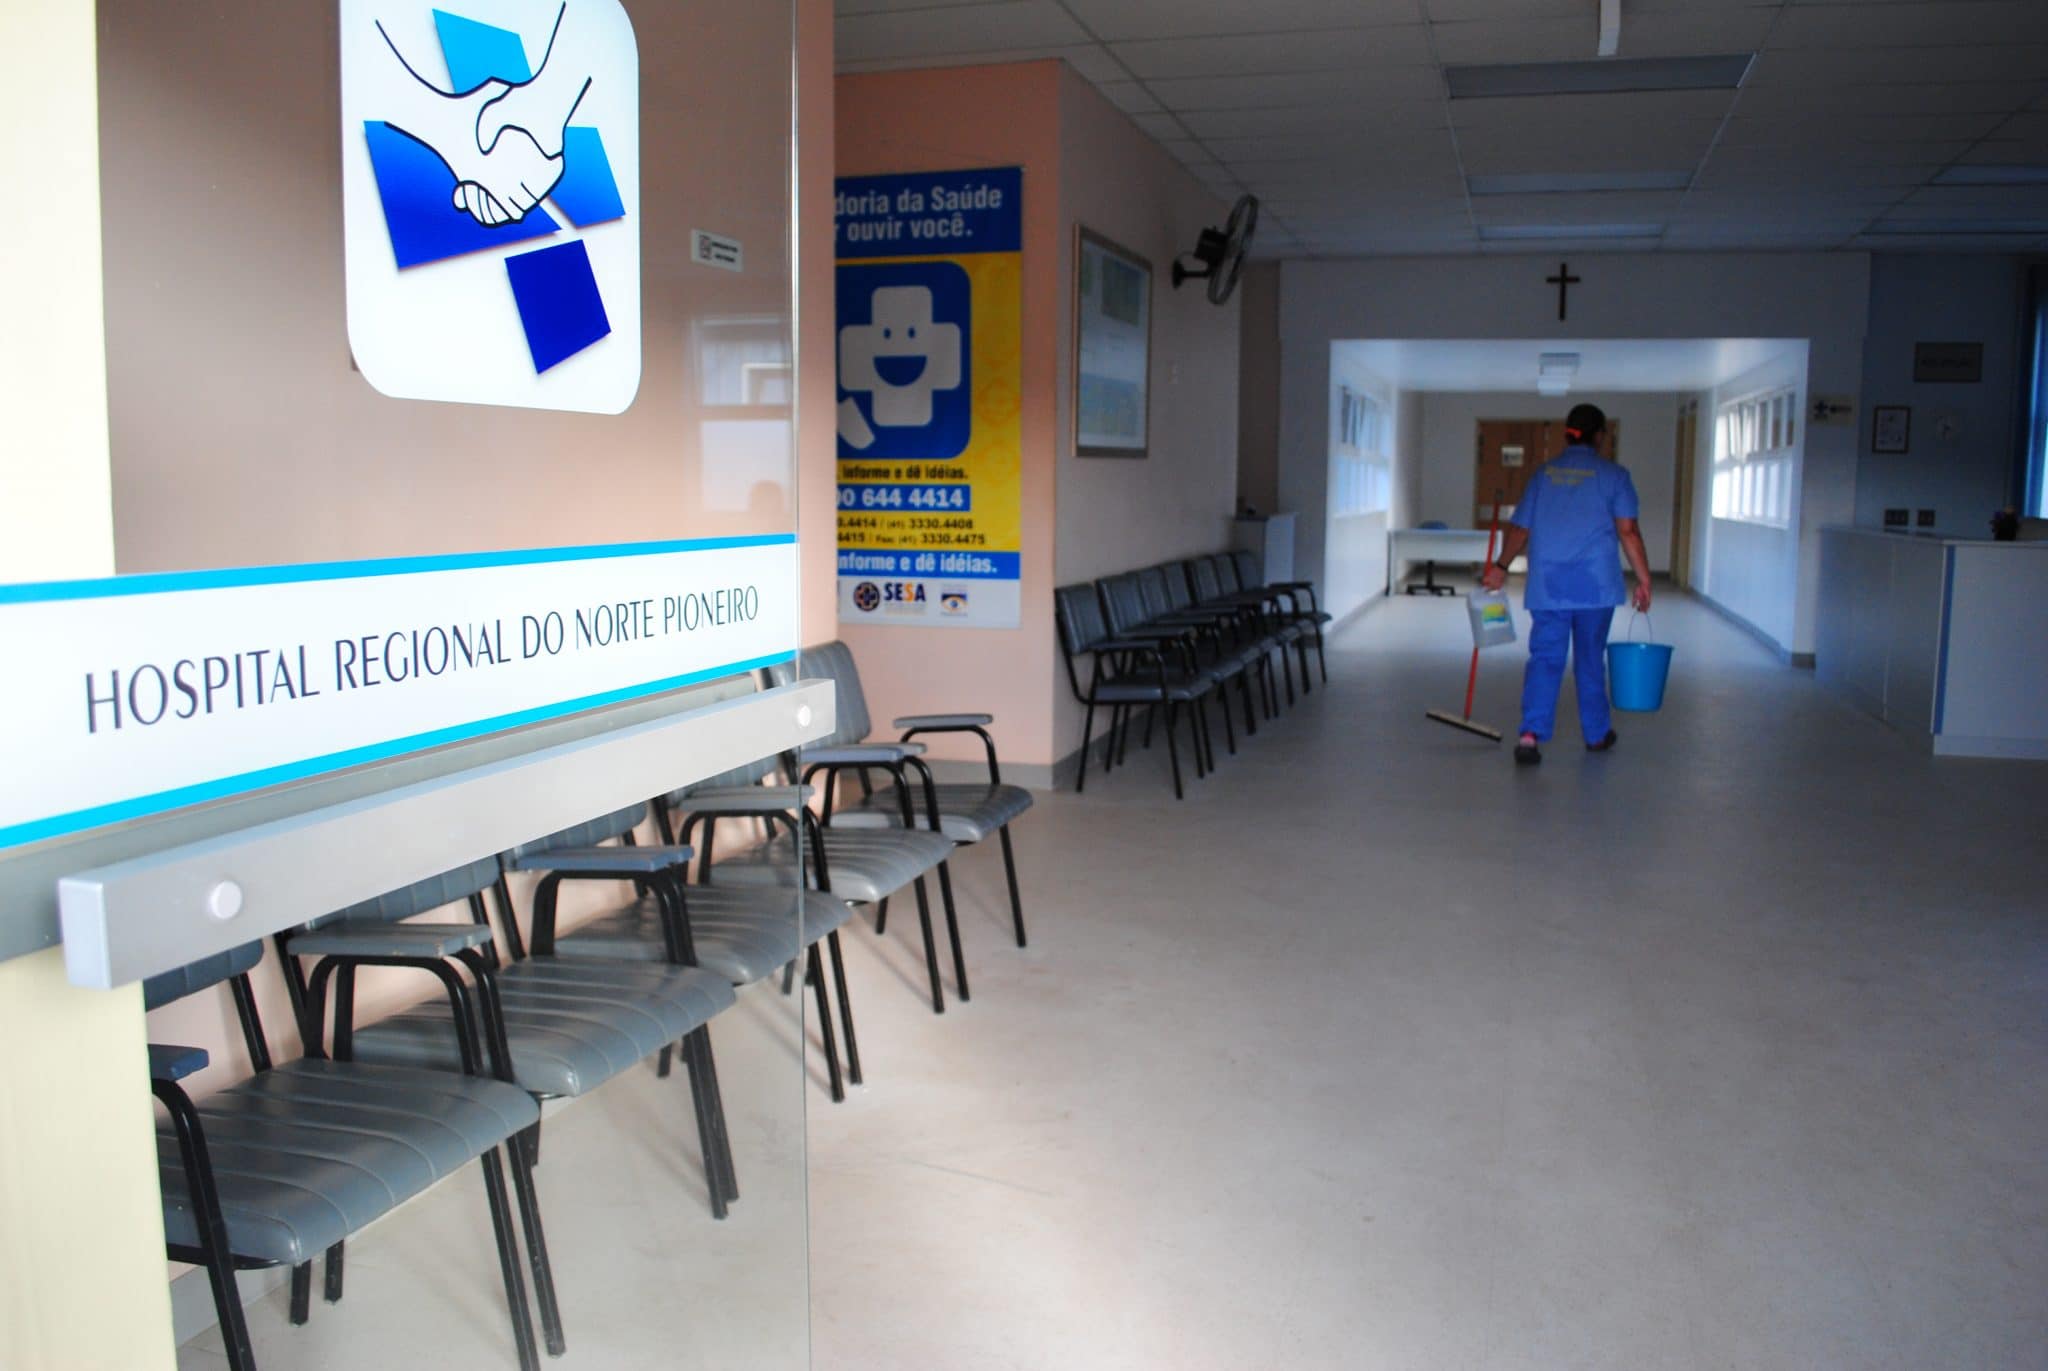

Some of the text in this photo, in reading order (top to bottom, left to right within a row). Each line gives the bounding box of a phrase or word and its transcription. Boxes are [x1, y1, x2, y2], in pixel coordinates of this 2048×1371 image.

[897, 188, 924, 213] da
[931, 184, 1003, 212] Saúde
[847, 216, 902, 242] ouvir
[910, 212, 974, 239] você.
[842, 463, 968, 480] informe e dê idéias.
[862, 487, 902, 507] 644
[908, 487, 964, 508] 4414
[900, 556, 911, 572] e
[915, 553, 936, 573] dê
[940, 553, 998, 574] idéias.
[883, 583, 927, 602] SESA
[86, 585, 759, 734] HOSPITAL REGIONAL DO NORTE PIONEIRO
